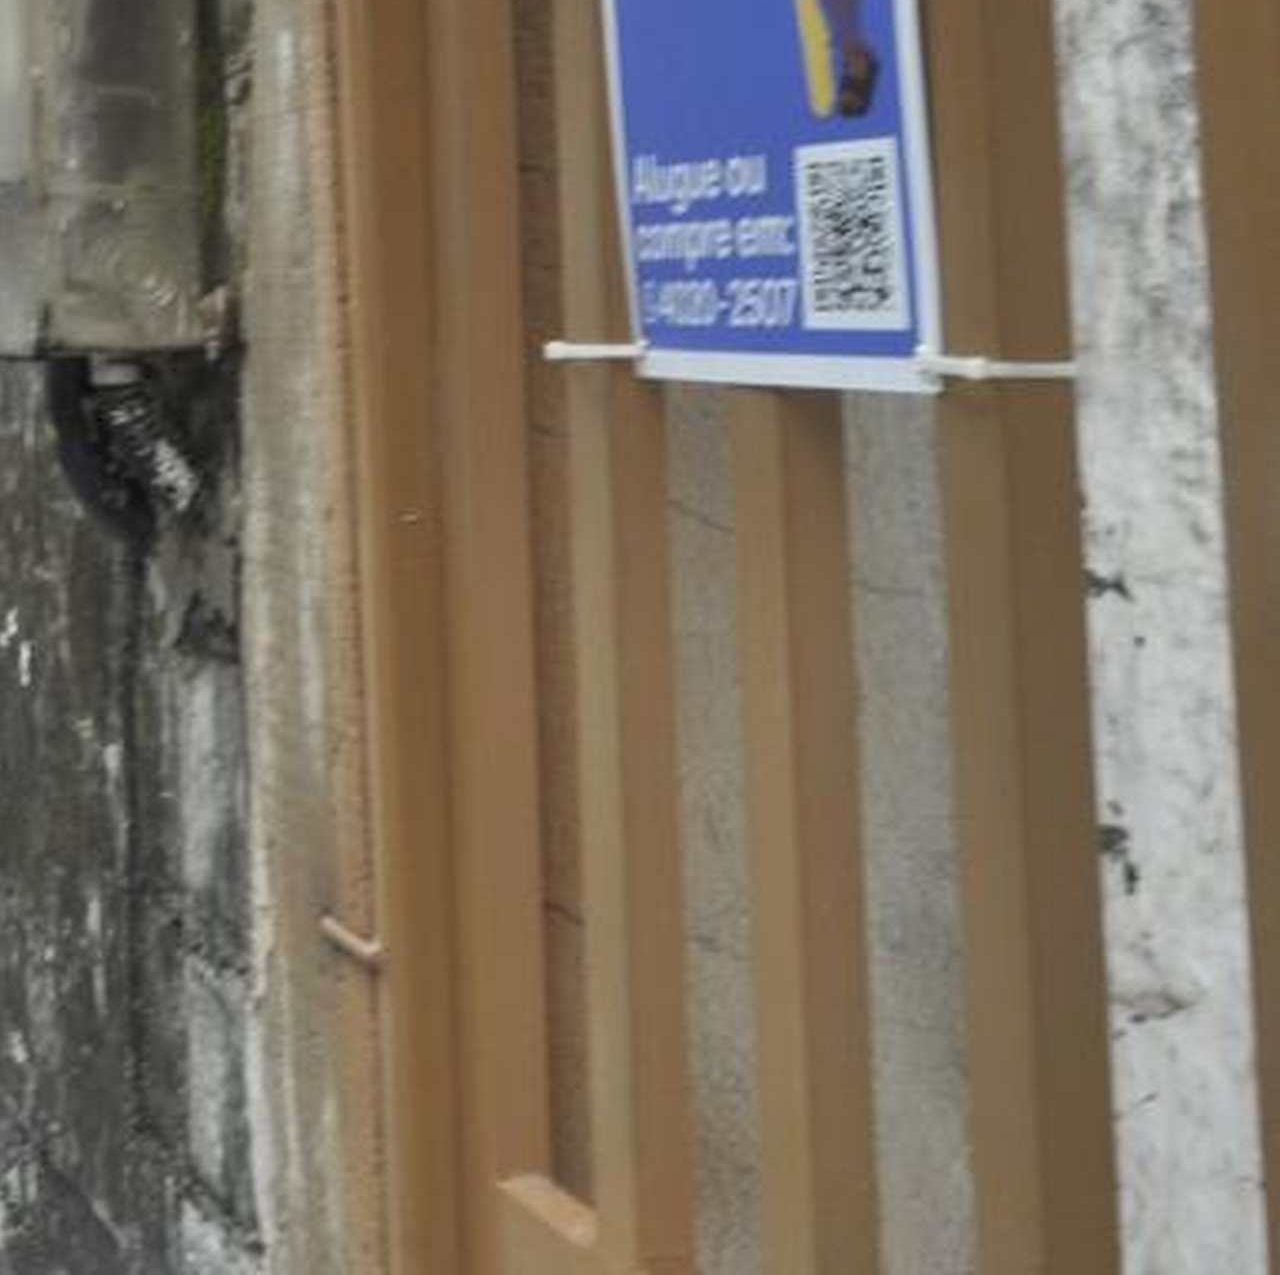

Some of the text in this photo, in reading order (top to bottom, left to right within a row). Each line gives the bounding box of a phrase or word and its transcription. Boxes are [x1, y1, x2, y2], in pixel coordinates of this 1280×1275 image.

[633, 153, 766, 215] Alugue ou
[636, 219, 732, 272] compre
